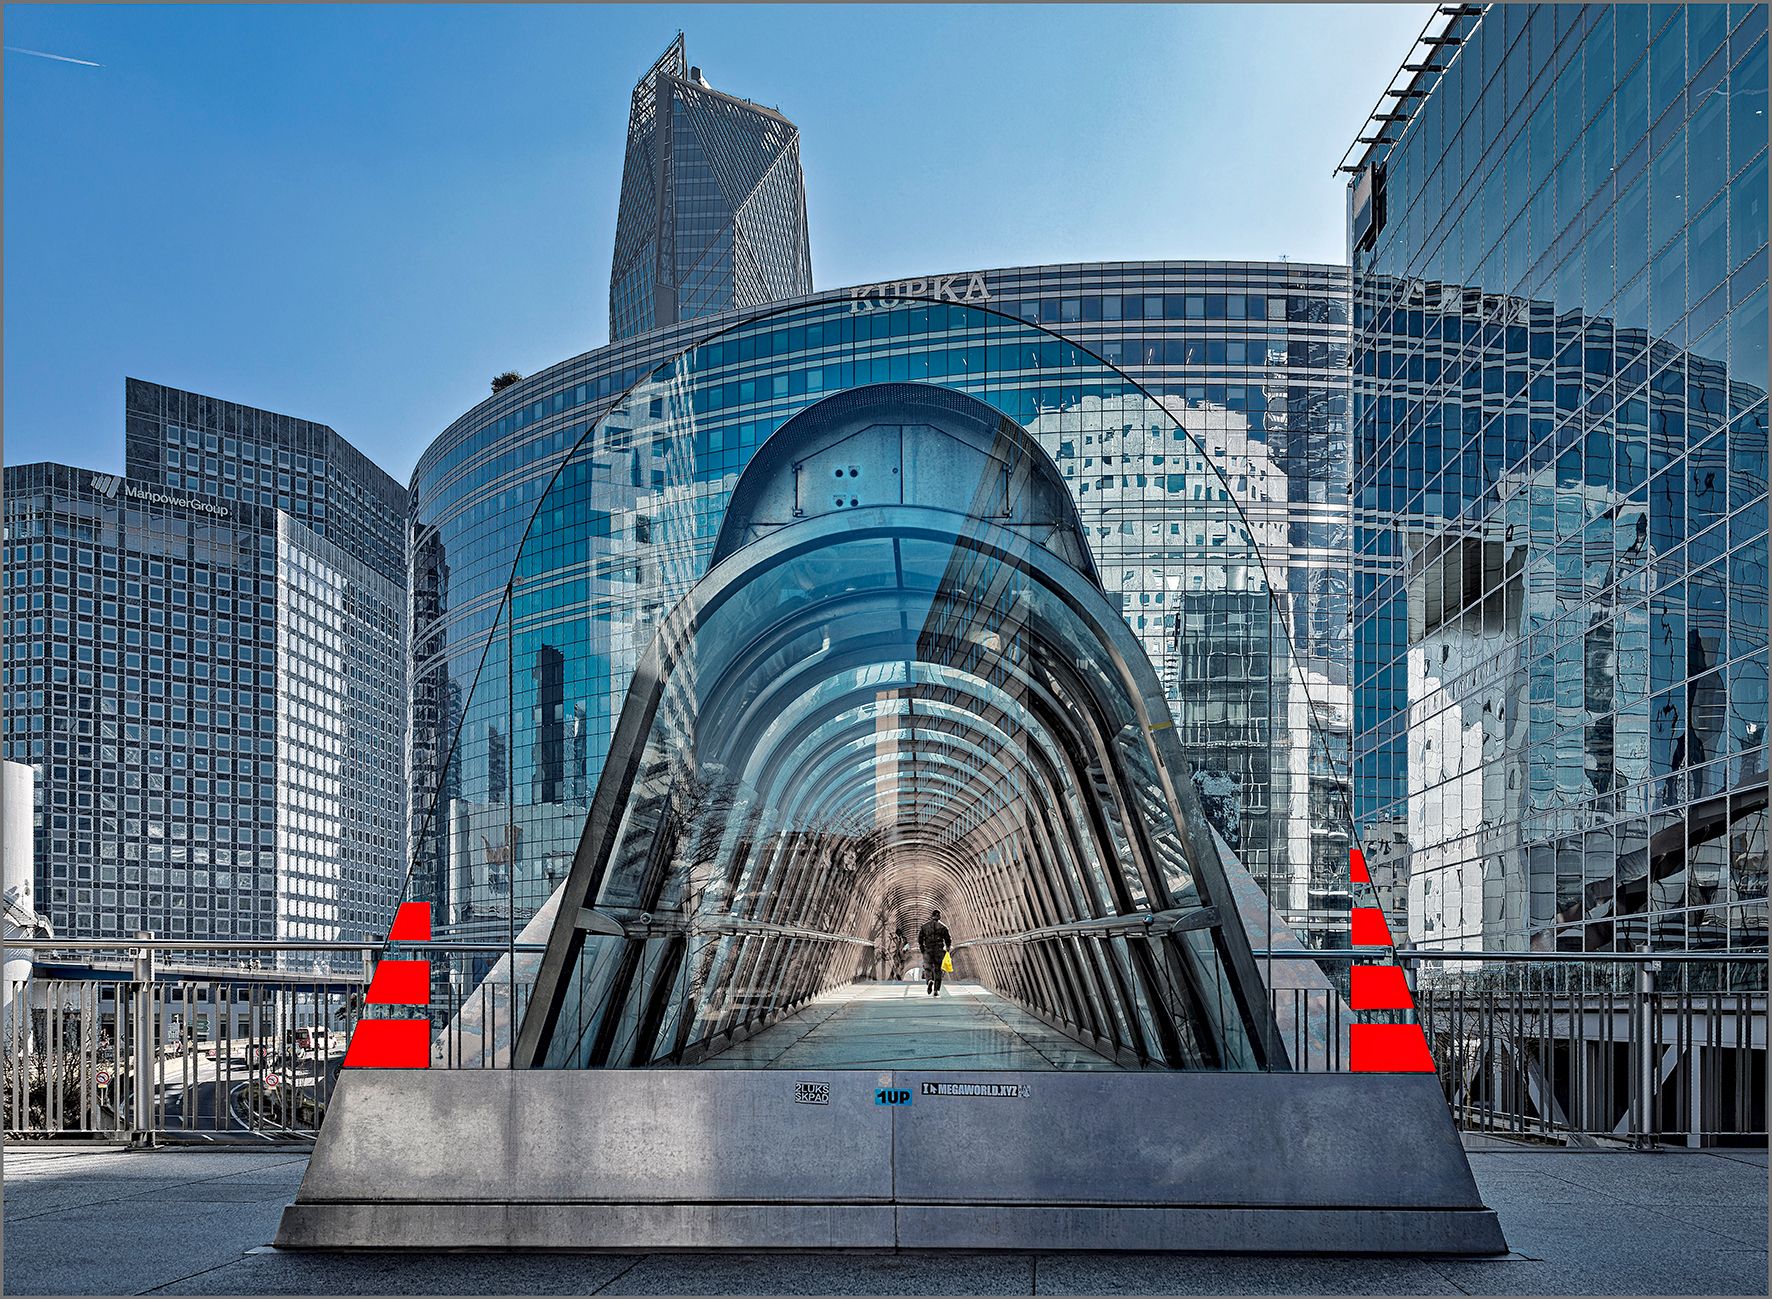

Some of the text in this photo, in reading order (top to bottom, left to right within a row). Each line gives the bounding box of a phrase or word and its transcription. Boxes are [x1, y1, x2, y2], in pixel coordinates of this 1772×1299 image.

[848, 273, 992, 314] KUPKA
[125, 485, 228, 516] ManpowerGroup
[877, 1090, 910, 1104] 1UP
[938, 1083, 1018, 1097] MEGAWORLD.XYZ
